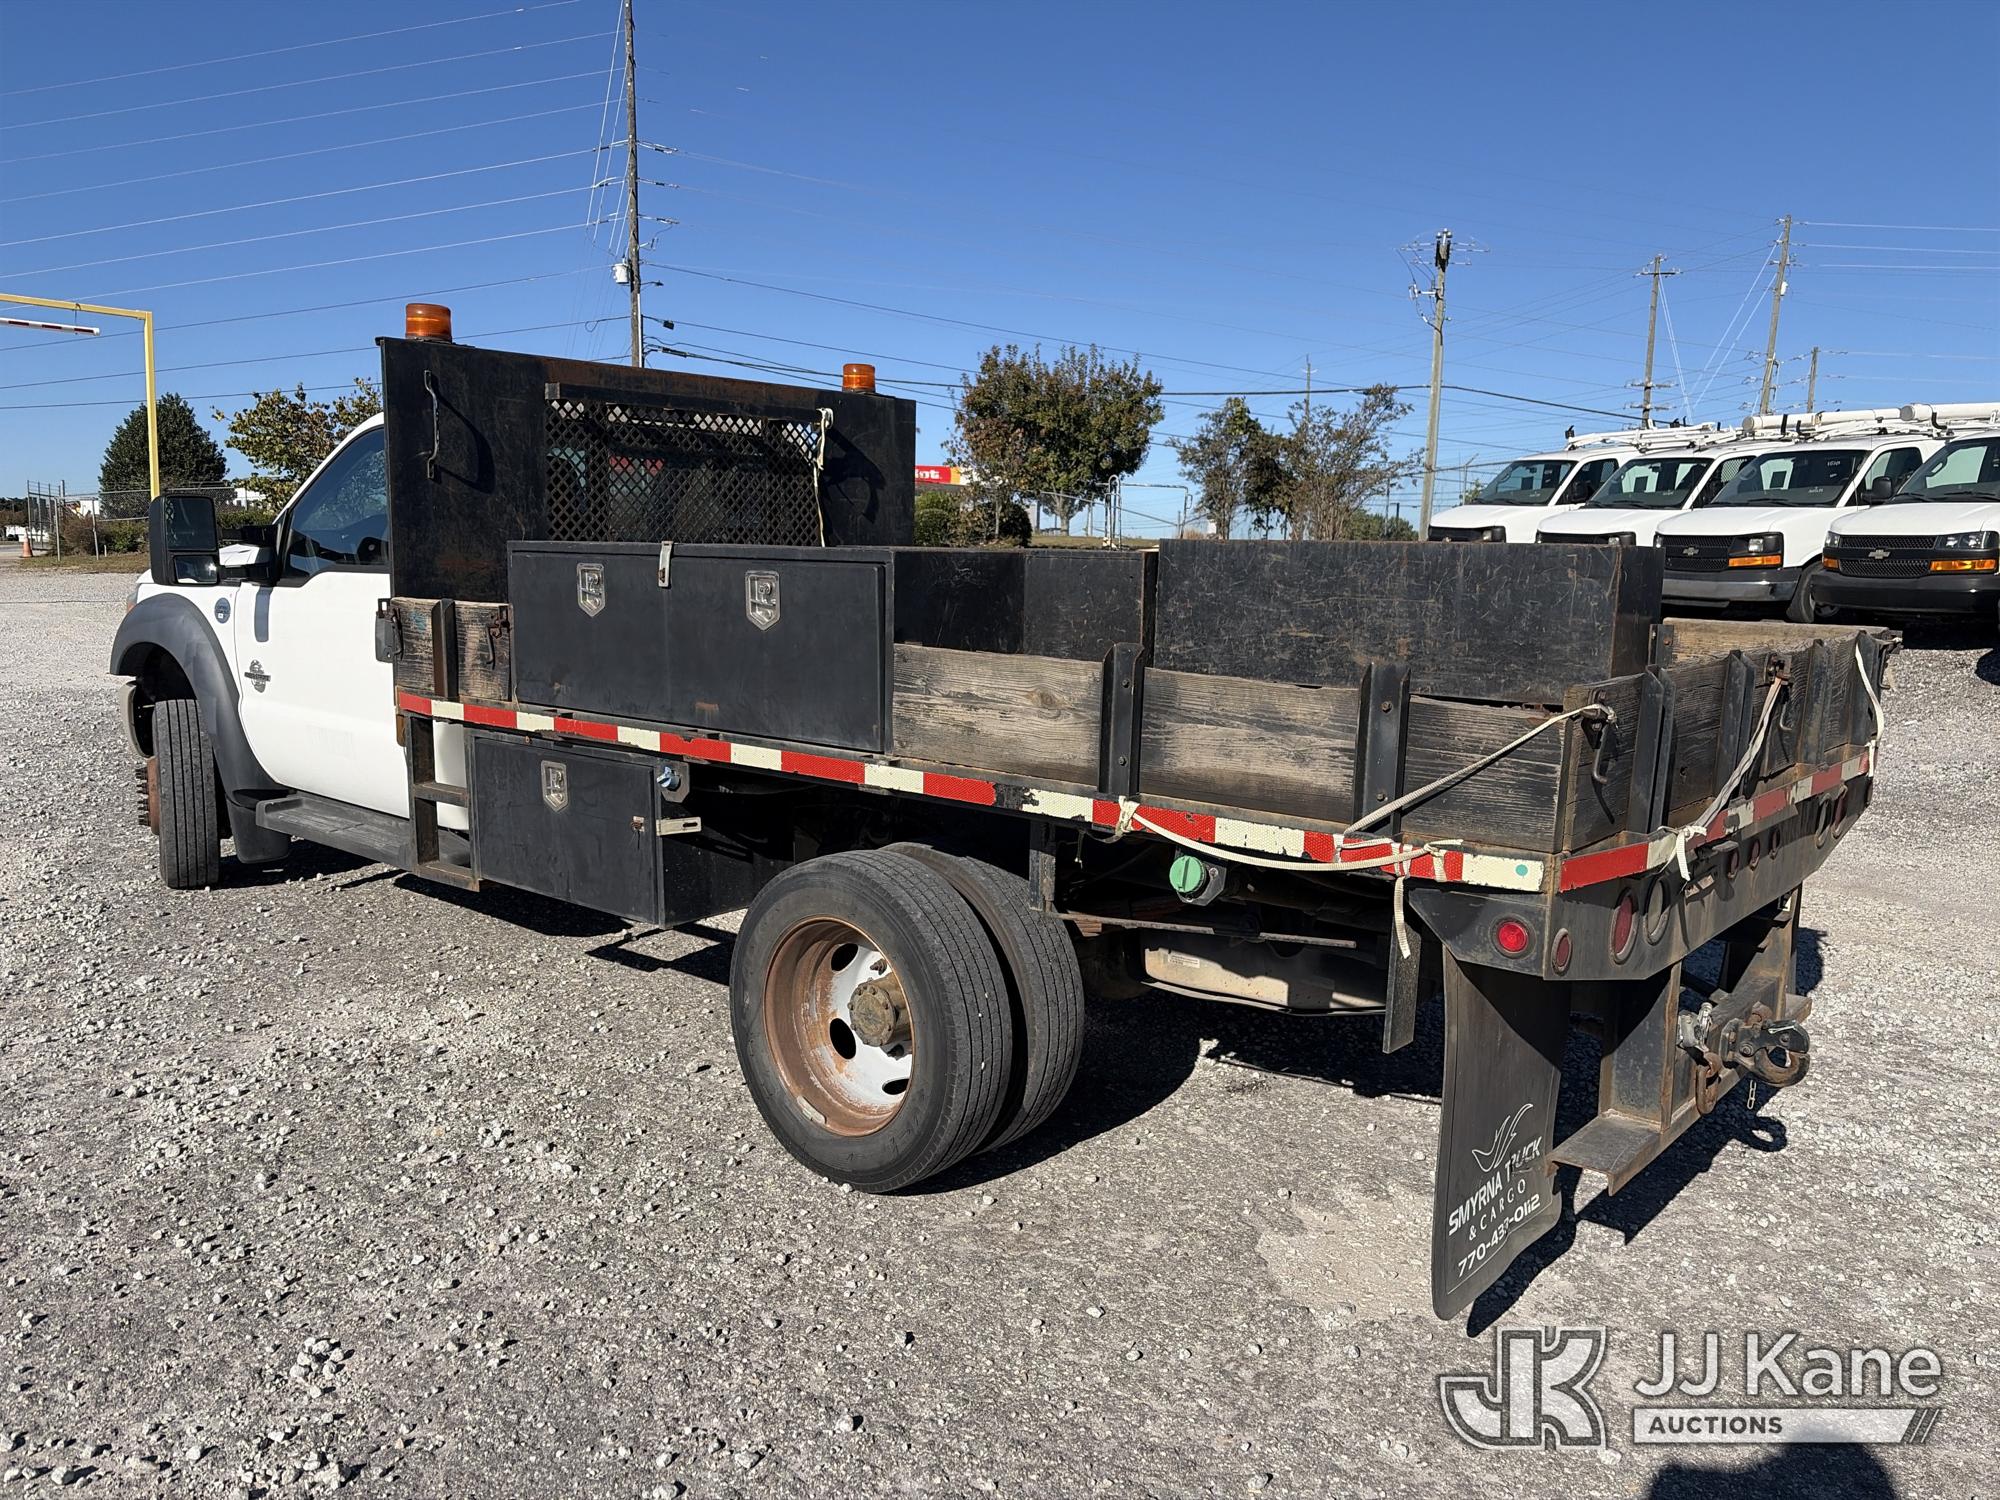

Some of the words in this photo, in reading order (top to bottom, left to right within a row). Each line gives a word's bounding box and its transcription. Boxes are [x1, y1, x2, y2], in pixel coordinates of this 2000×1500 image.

[1448, 1170, 1503, 1236] SMYRNA
[1504, 1136, 1543, 1183] TRUCK
[1469, 1225, 1477, 1241] &
[1480, 1178, 1526, 1230] CARGO
